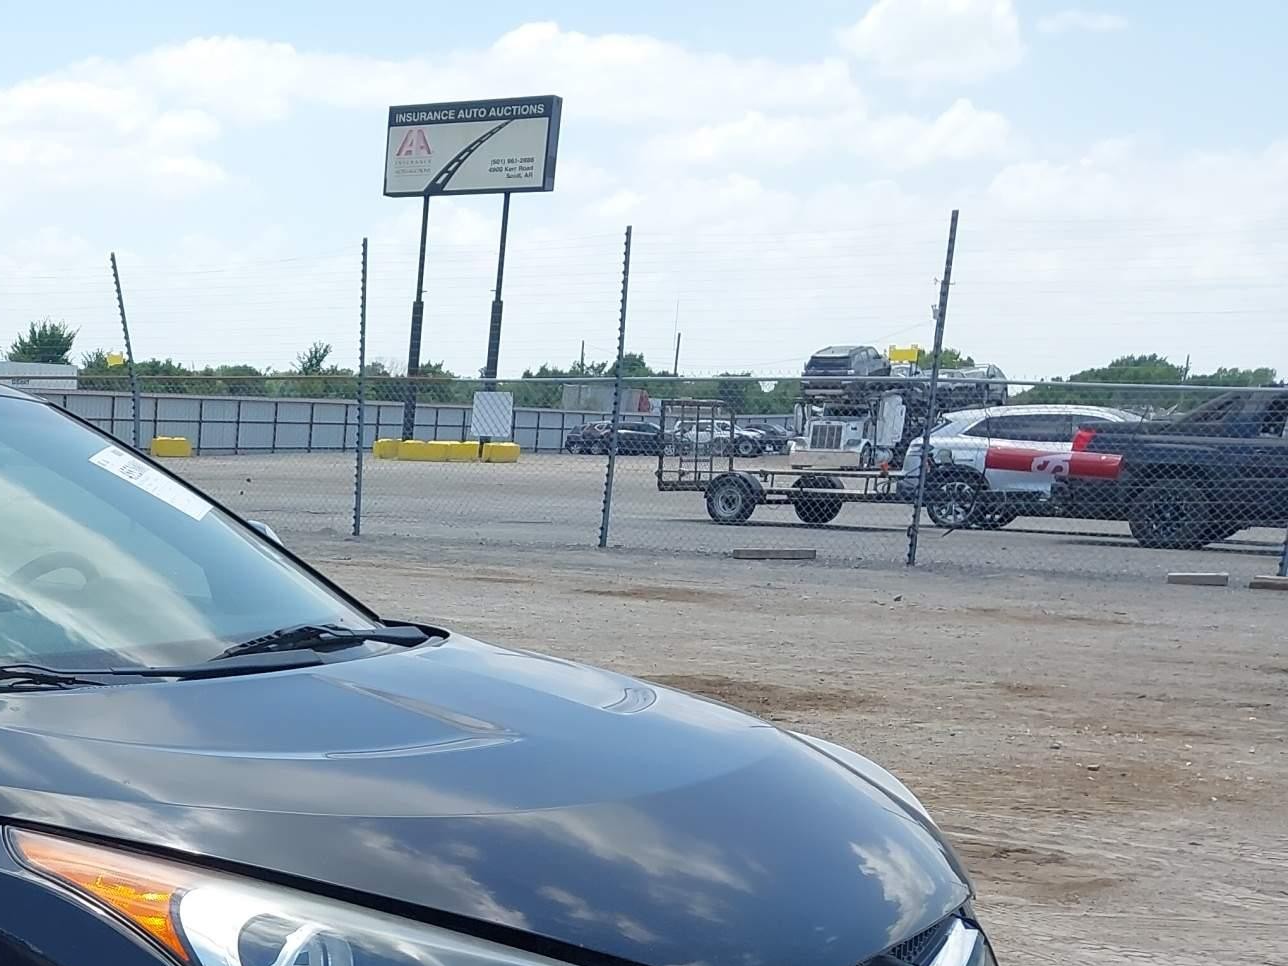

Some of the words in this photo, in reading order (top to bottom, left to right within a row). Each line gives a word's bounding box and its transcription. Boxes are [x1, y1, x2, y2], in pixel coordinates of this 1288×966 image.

[396, 110, 456, 123] INSURANCE
[458, 108, 486, 119] AUTO
[488, 104, 544, 117] AUCTIONS
